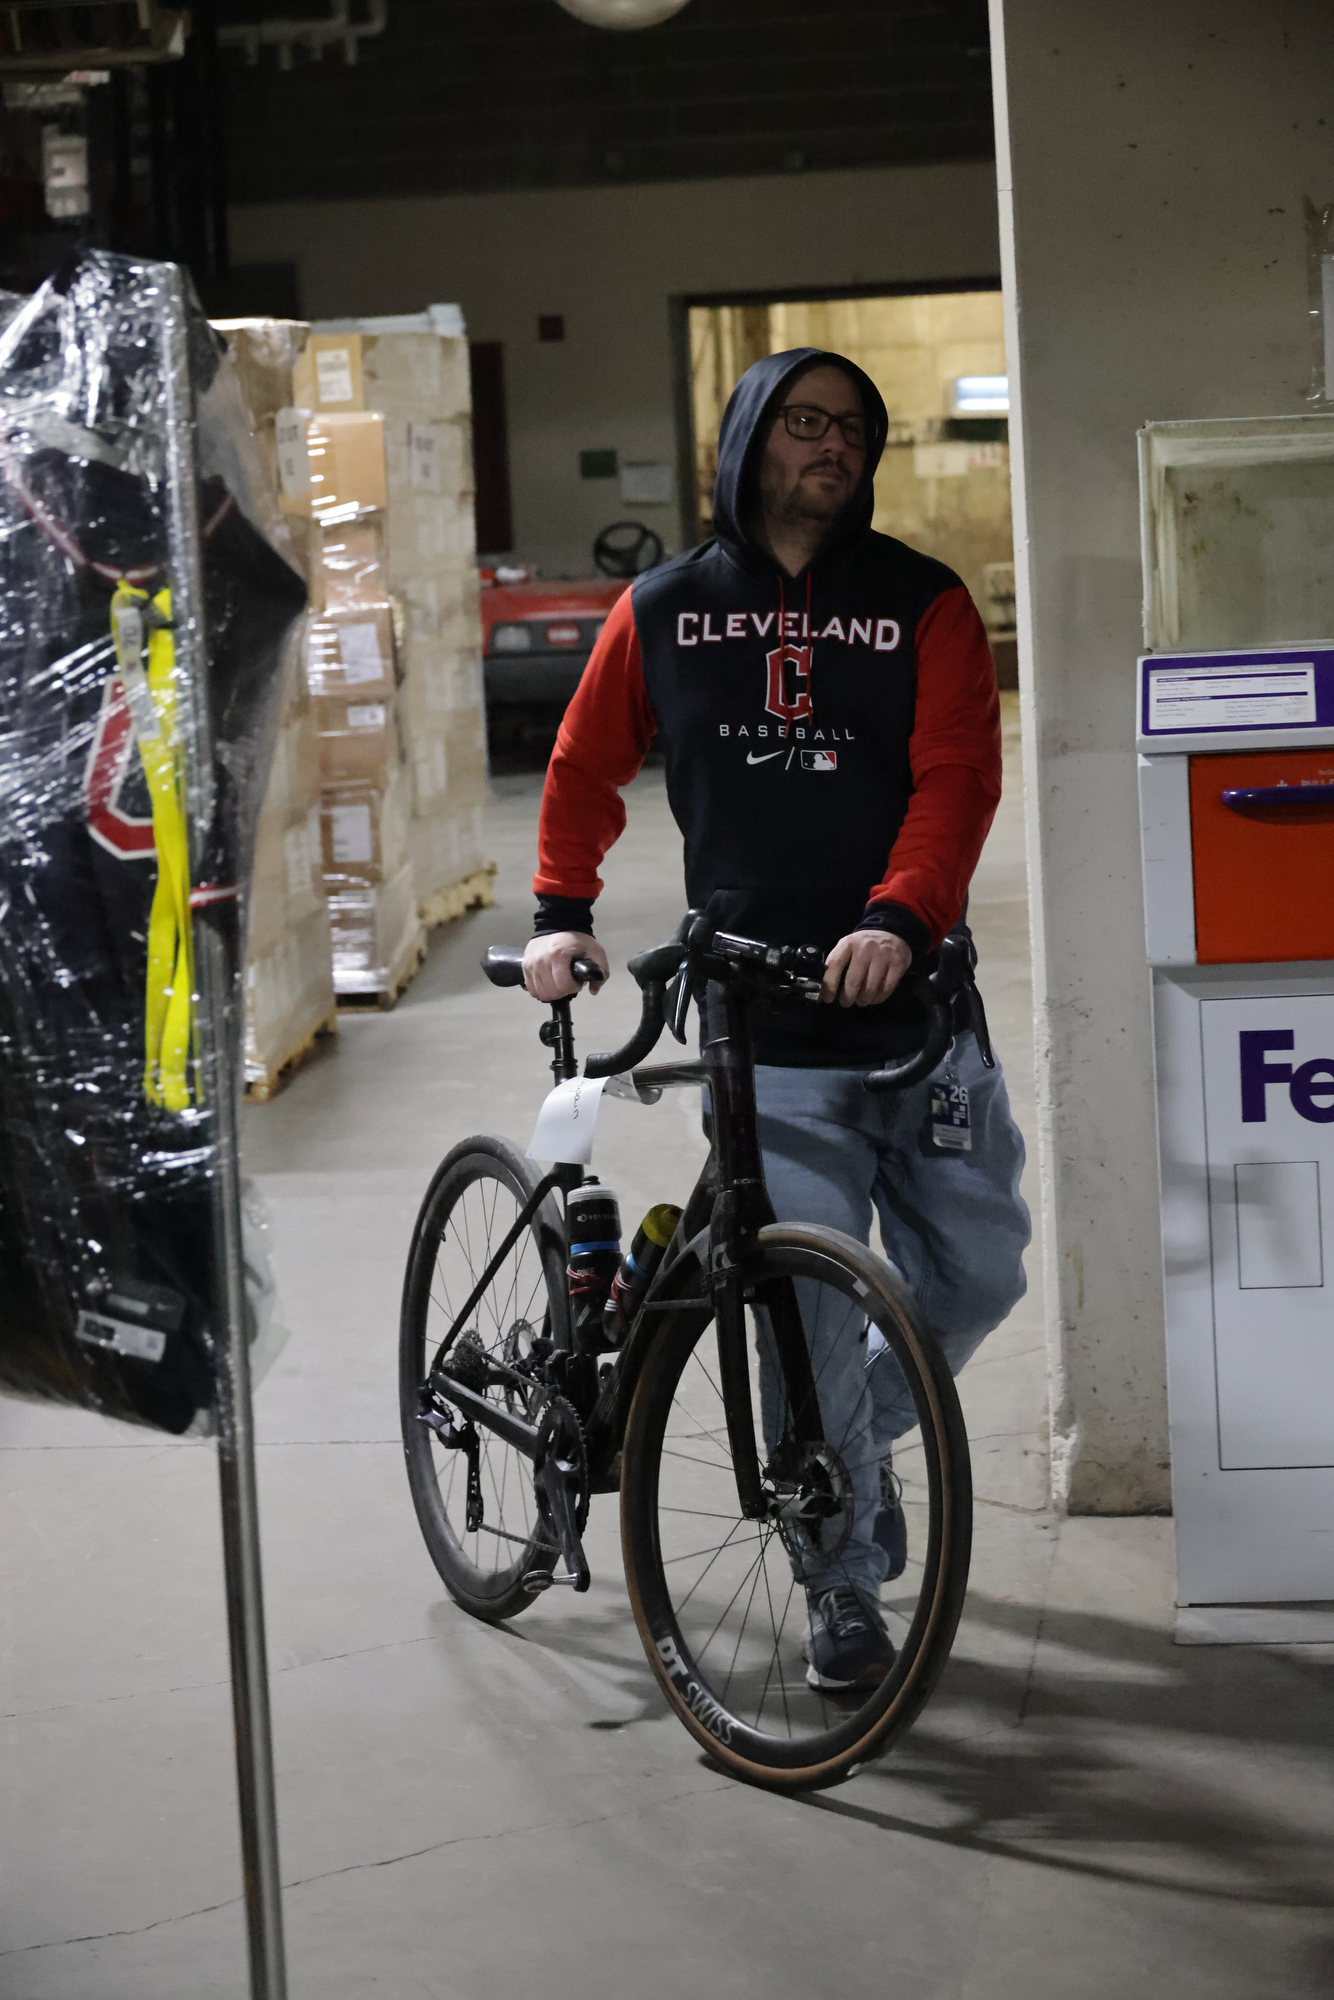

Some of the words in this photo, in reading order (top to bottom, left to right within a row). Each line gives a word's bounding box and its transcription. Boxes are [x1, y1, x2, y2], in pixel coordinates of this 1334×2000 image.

[677, 611, 901, 651] CLEVELAND
[719, 724, 855, 741] BASEBALL
[949, 1084, 969, 1105] 26
[656, 1635, 689, 1678] DT
[680, 1681, 739, 1745] SWISS
